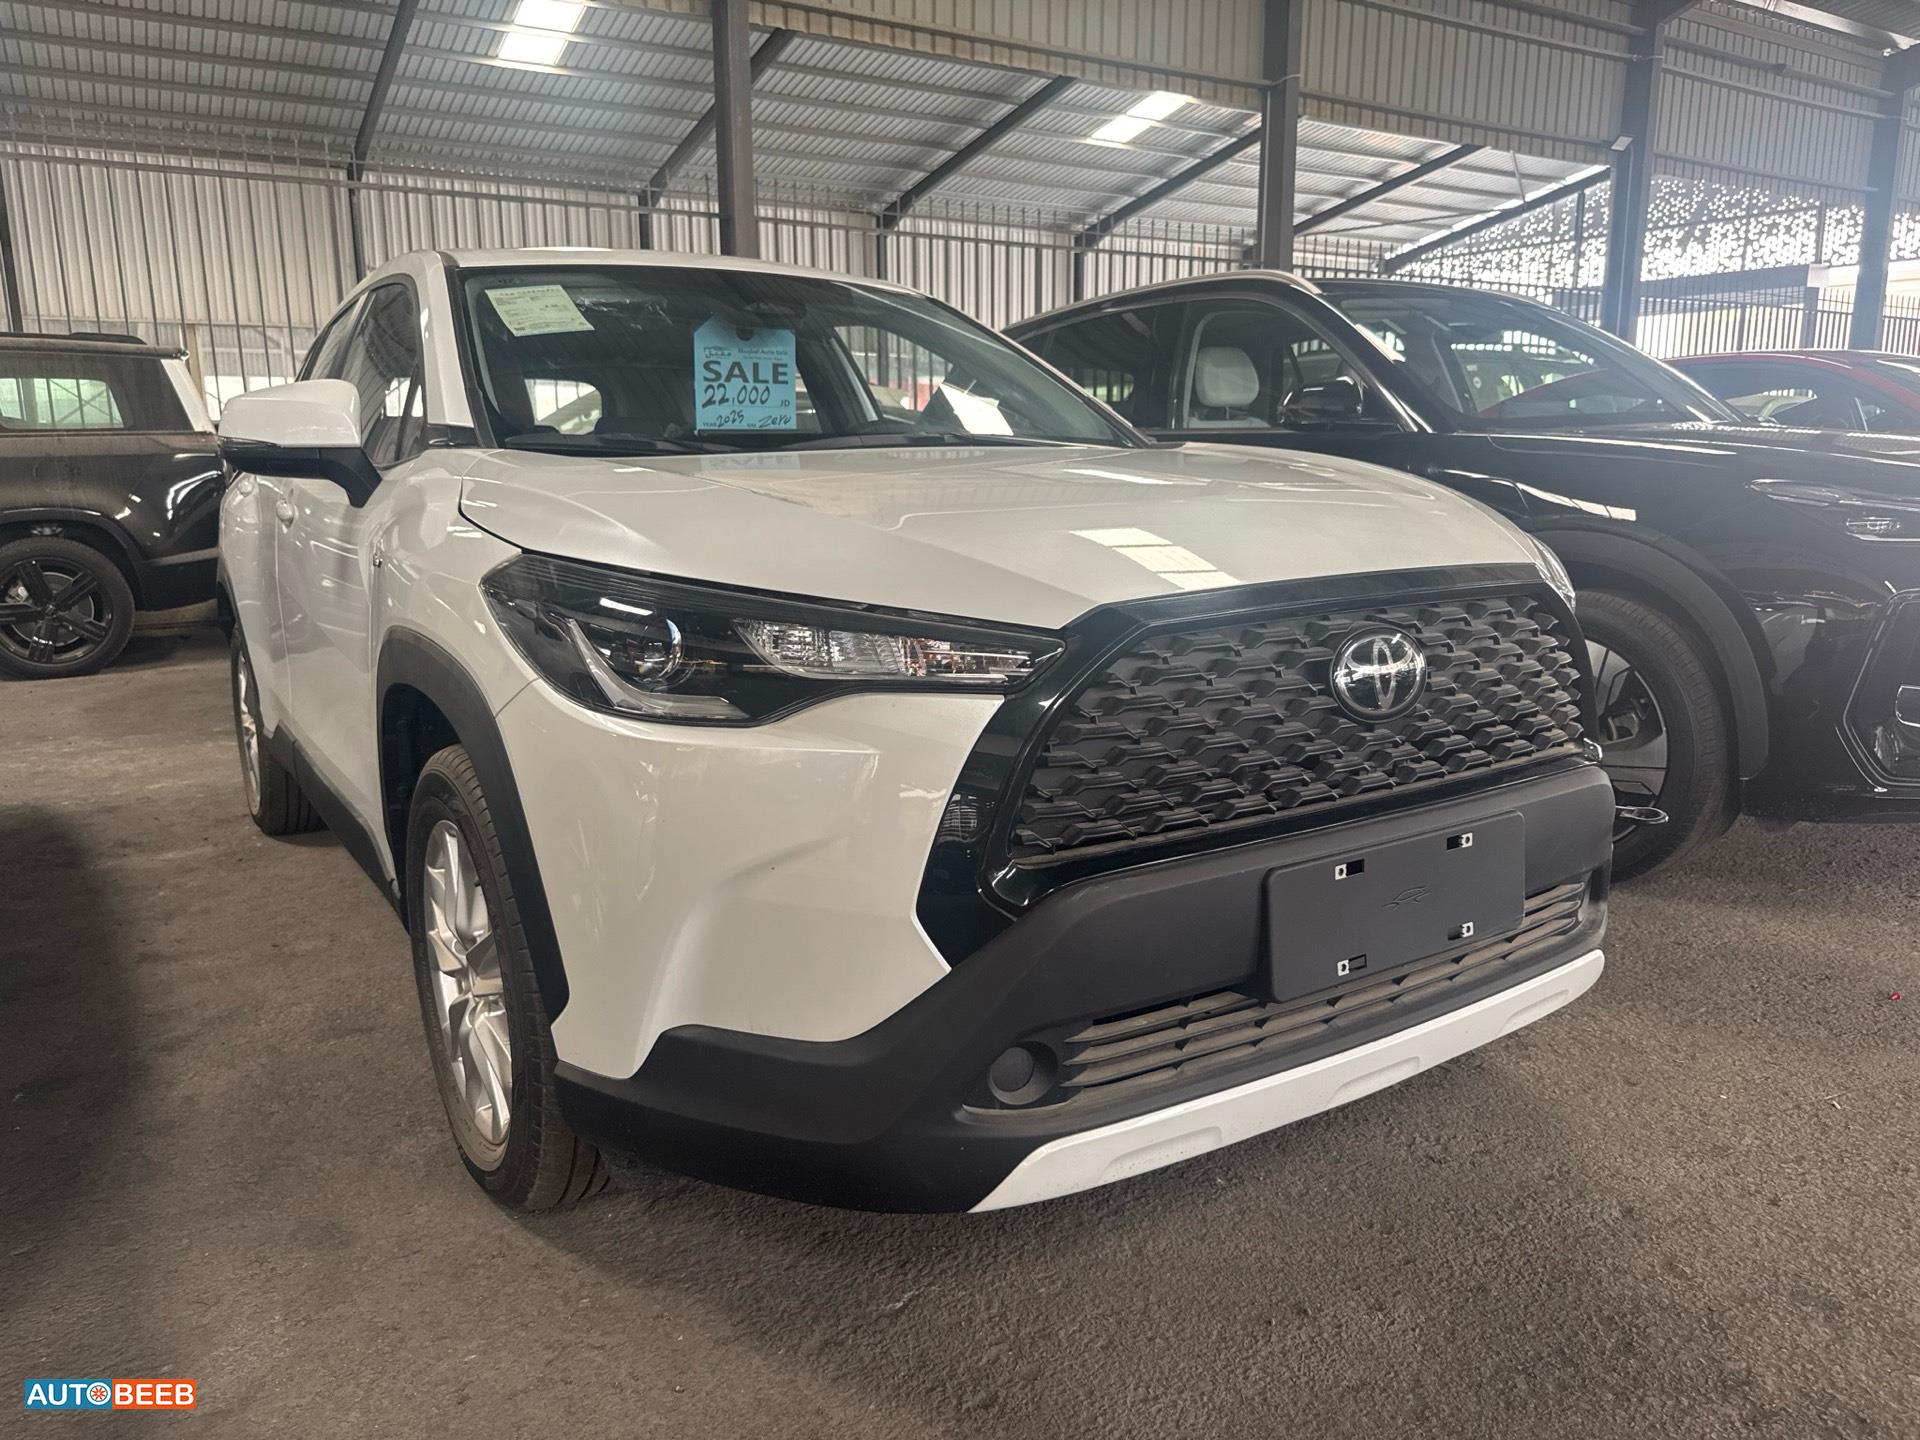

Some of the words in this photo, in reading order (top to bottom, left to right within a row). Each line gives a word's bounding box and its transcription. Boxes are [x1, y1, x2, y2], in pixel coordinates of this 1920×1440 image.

[703, 360, 789, 384] SALE
[702, 383, 770, 408] 22,000
[716, 410, 744, 428] 2025
